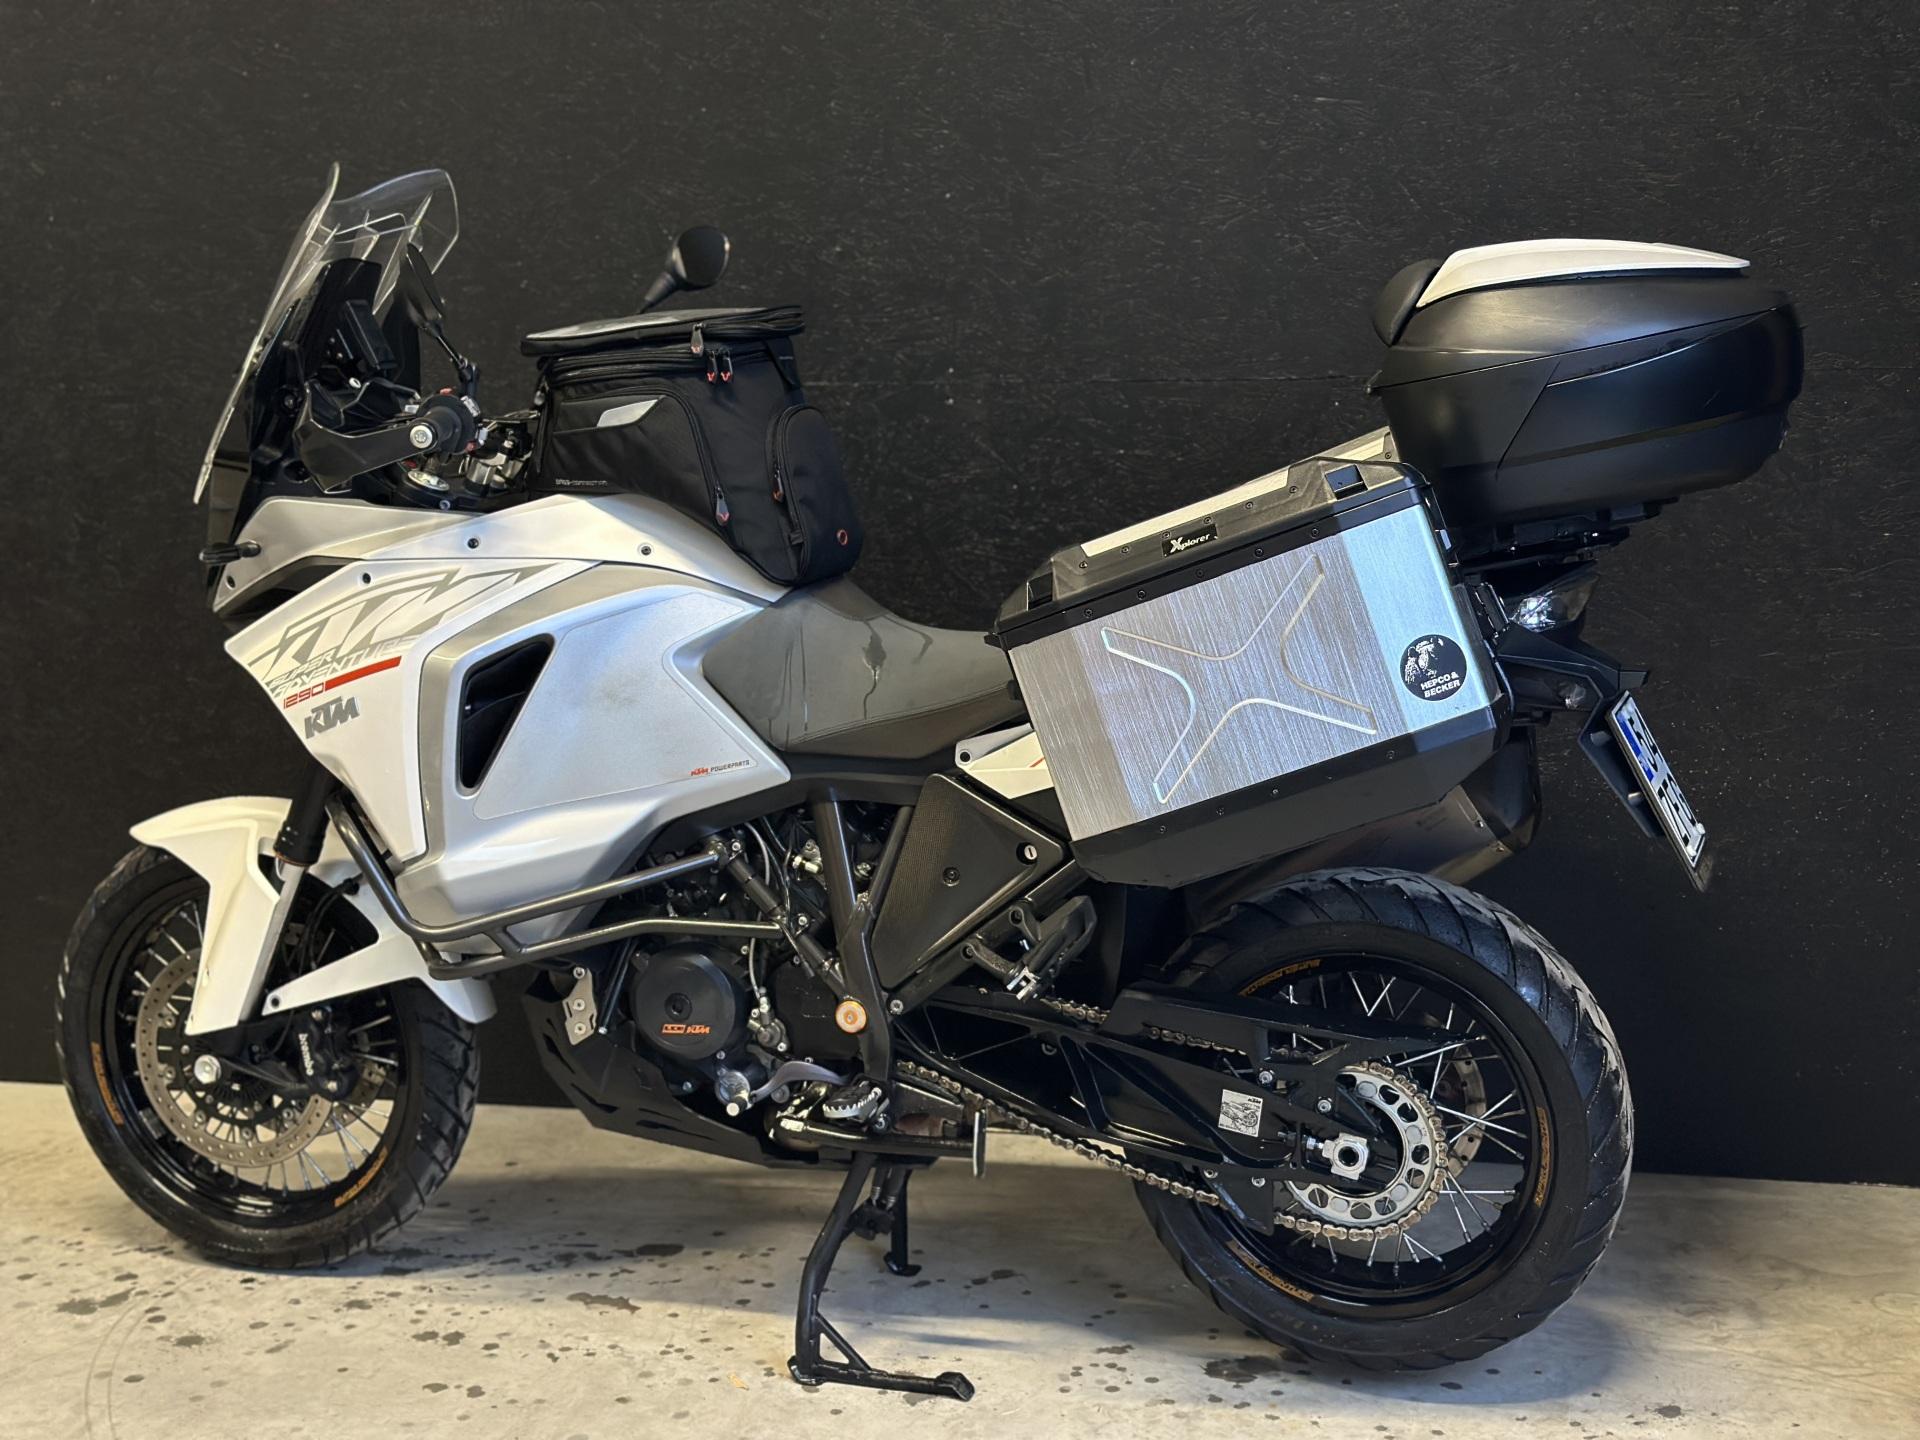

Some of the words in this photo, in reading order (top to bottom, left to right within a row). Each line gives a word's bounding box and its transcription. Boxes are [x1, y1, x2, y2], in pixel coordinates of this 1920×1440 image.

[1170, 534, 1210, 553] Xplorer
[1420, 673, 1450, 690] HEPCO
[1450, 671, 1459, 680] &
[1424, 679, 1461, 698] BECKER
[284, 682, 324, 710] 1290
[304, 696, 361, 739] KTM
[298, 1033, 314, 1076] brembo
